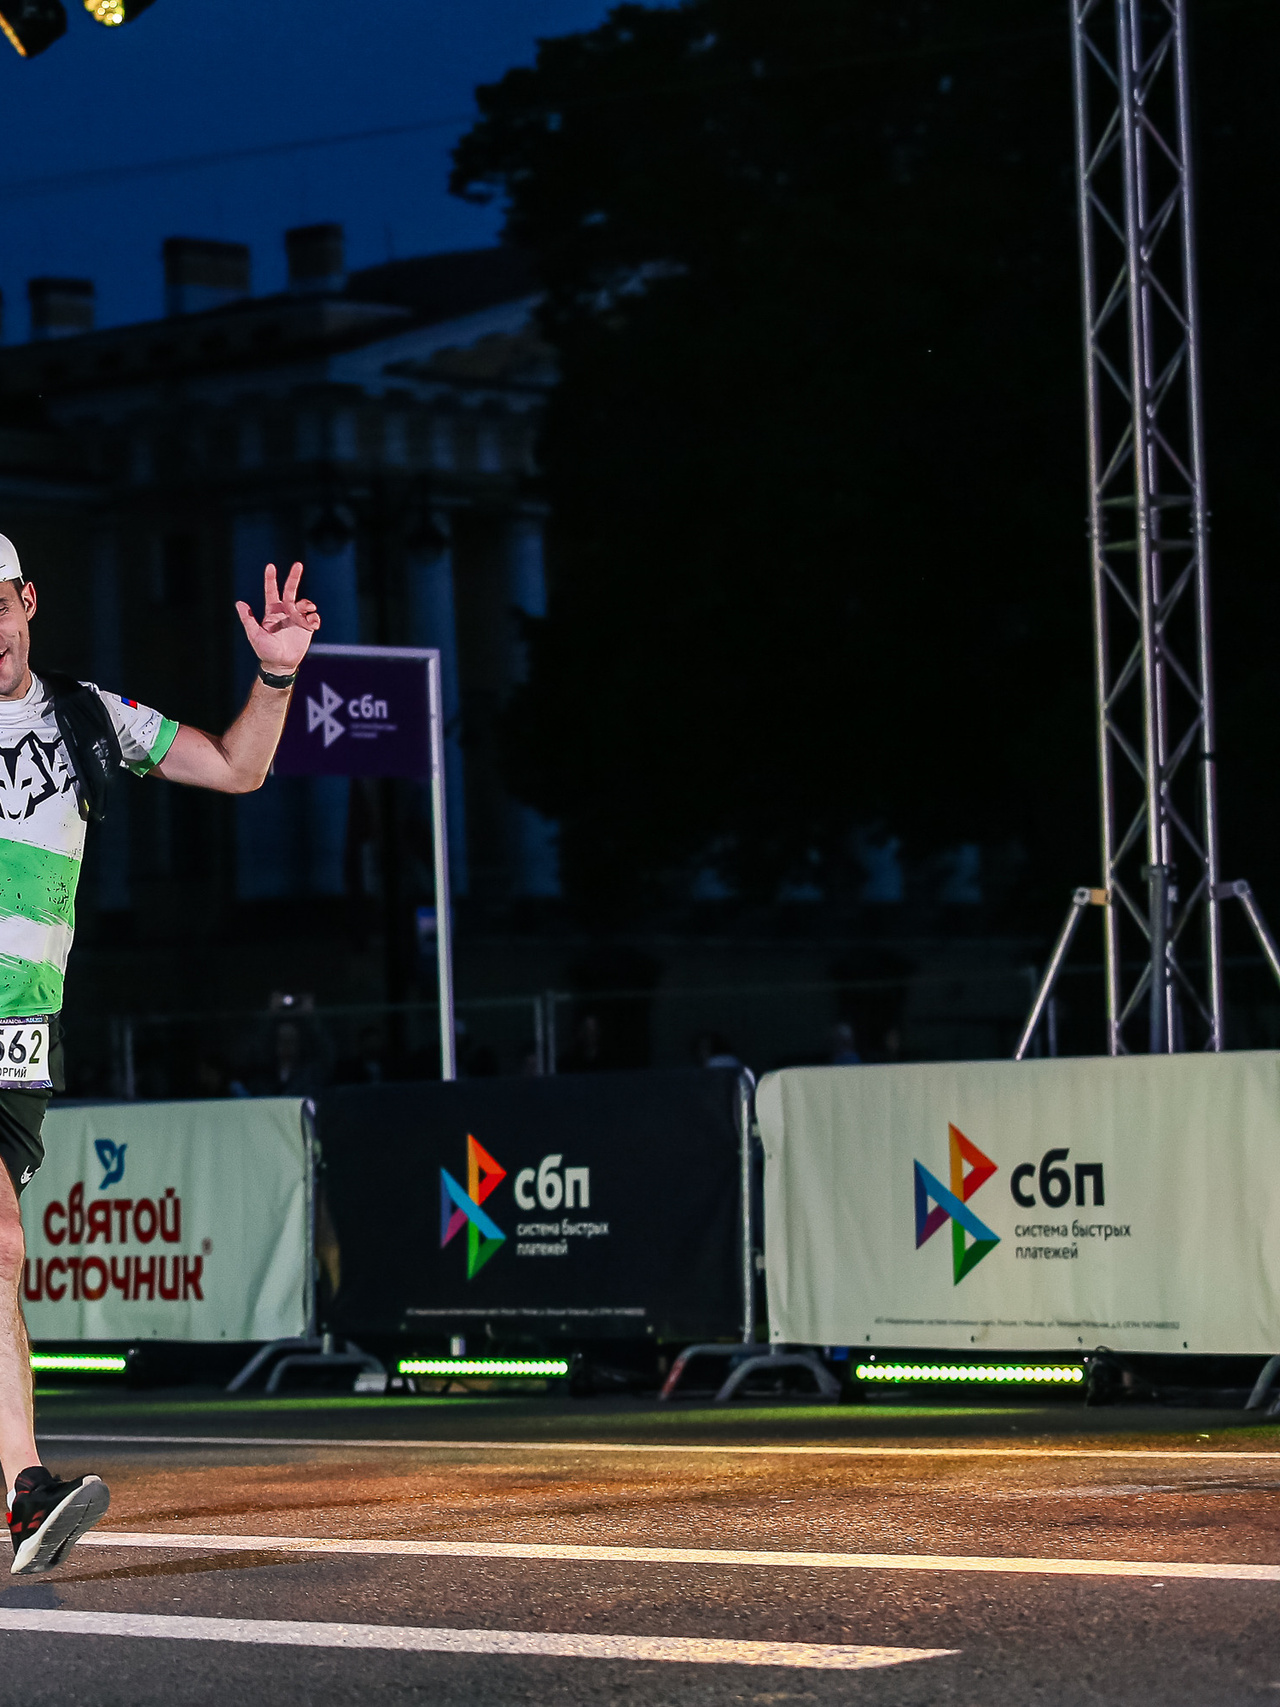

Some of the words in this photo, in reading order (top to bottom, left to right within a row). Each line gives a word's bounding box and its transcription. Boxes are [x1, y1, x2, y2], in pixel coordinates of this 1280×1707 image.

[348, 694, 388, 719] сбп
[515, 1153, 590, 1210] сбп
[1010, 1148, 1105, 1208] сбп
[43, 1181, 181, 1246] святой
[517, 1223, 560, 1237] система
[562, 1219, 609, 1239] быстрых
[1014, 1224, 1069, 1238] система
[1071, 1219, 1131, 1241] быстрых
[1015, 1242, 1079, 1260] платежей
